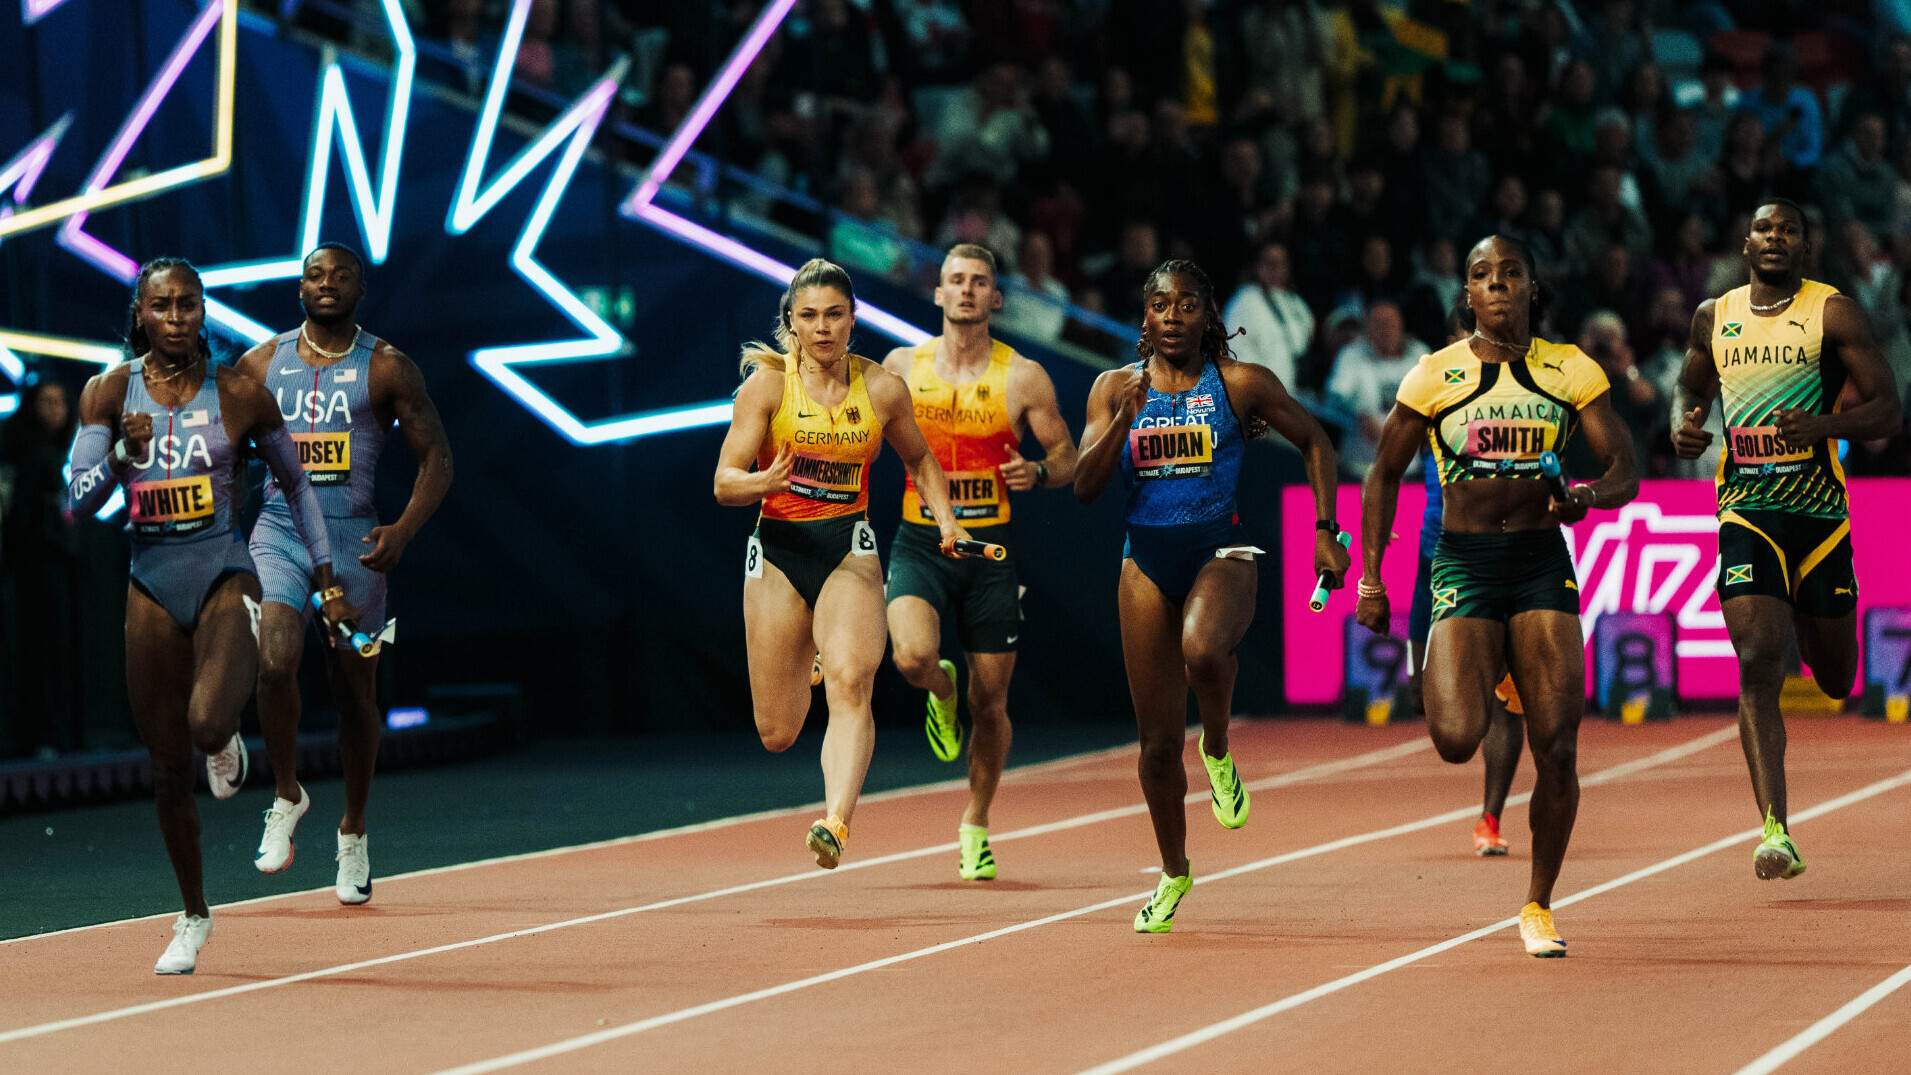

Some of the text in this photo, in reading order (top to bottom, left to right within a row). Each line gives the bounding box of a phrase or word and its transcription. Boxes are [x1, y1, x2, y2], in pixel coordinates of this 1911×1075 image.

[1722, 345, 1808, 368] JAMAICA
[276, 387, 352, 424] USA
[913, 403, 997, 424] GERMANY
[1186, 406, 1216, 416] Novuna
[1459, 403, 1561, 426] JAMAICA
[794, 429, 870, 445] GERMANY
[1137, 431, 1204, 461] EDUAN
[1477, 426, 1545, 454] SMITH
[294, 440, 345, 465] DSEY
[74, 464, 105, 500] USA
[311, 474, 338, 482] BUDAPEST
[1138, 469, 1160, 477] ULTIMATE
[1175, 466, 1201, 475] BUDAPEST
[137, 484, 206, 518] WHITE
[826, 492, 850, 500] BUDAPEST
[949, 479, 993, 500] NTER
[858, 528, 874, 551] 8
[748, 544, 757, 572] 8
[1363, 634, 1404, 695] 9
[1614, 632, 1655, 692] 8
